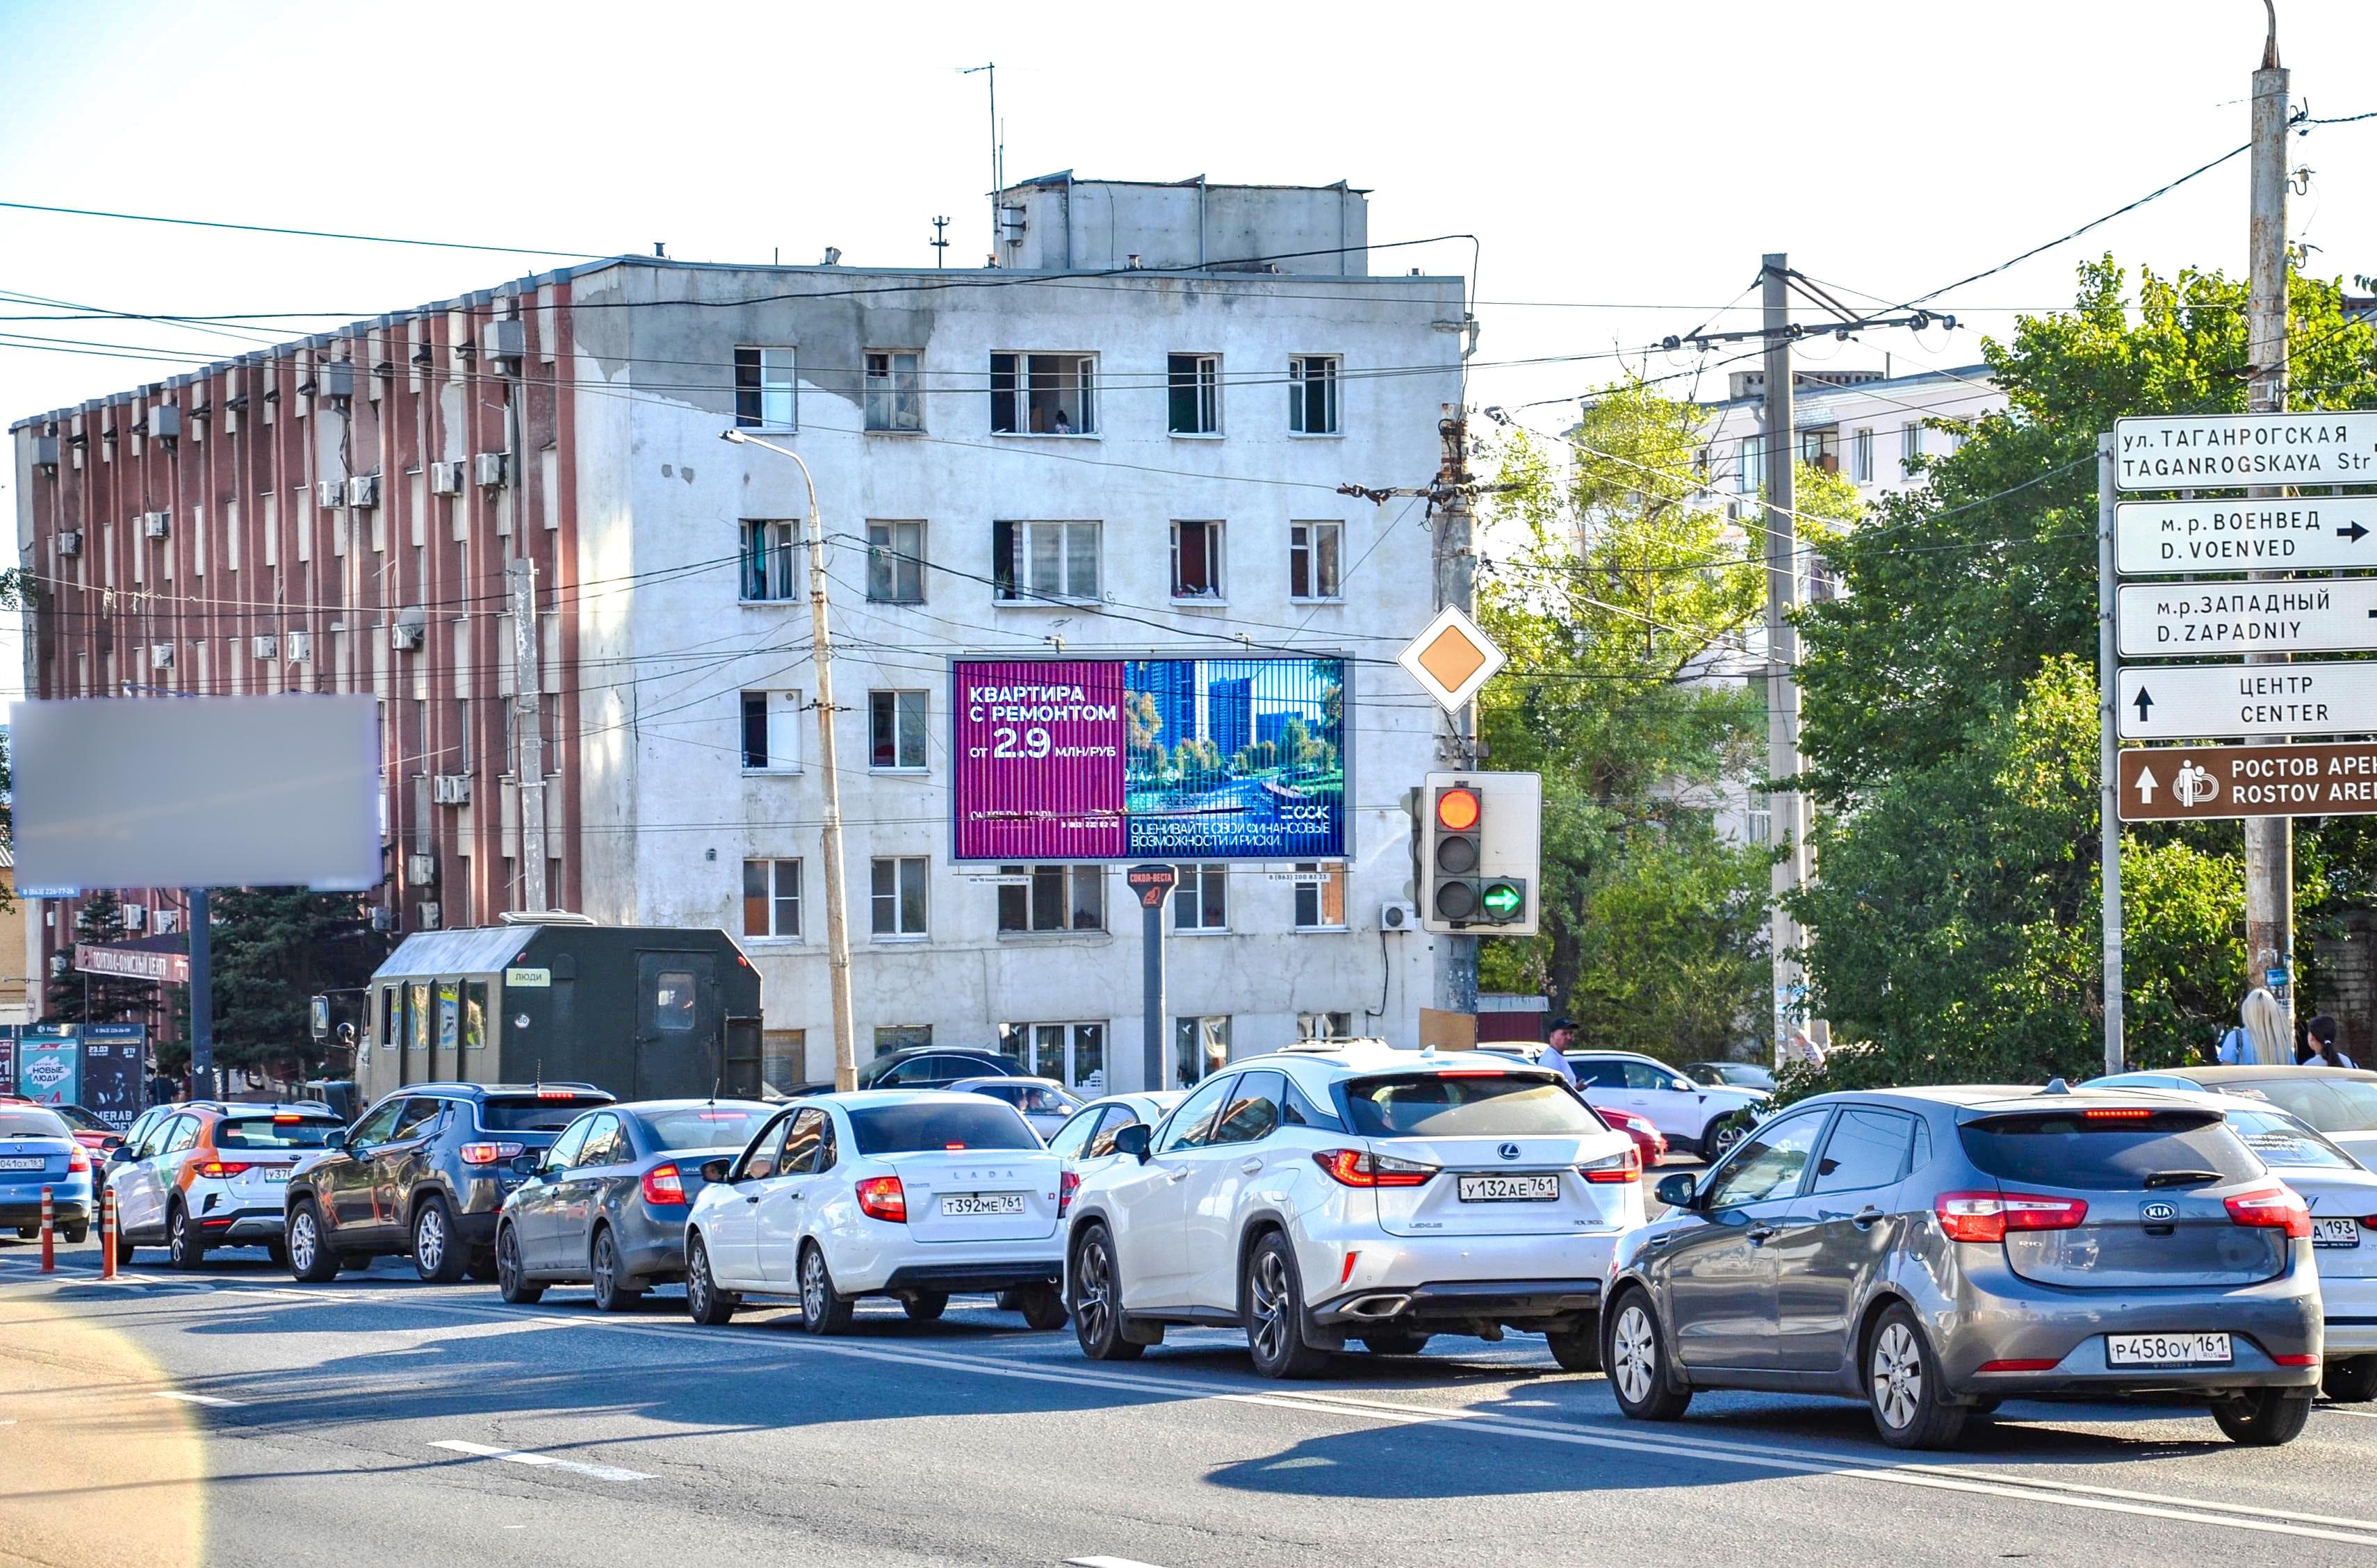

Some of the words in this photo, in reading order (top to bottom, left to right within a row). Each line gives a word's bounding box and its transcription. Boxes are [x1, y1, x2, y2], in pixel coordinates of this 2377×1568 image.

[2123, 435, 2154, 452] ул.
[2161, 426, 2346, 447] ТАГАНРОГСКАЯ
[2123, 453, 2321, 477] TAGANROGSKAYA
[2338, 452, 2371, 470] Str
[2189, 539, 2296, 559] VOENVED
[2185, 621, 2301, 642] ZAPADNIY
[970, 686, 1086, 703] КВАРТИРА
[2240, 677, 2313, 697] ЦЕНТР
[970, 705, 983, 723] С
[992, 705, 1116, 722] РЕМОНТОМ
[2241, 704, 2328, 723] CENTER
[993, 727, 1051, 759] 2.9
[2232, 759, 2319, 778] РОСТОВ
[2232, 783, 2320, 804] ROSTOV
[1131, 821, 1209, 835] ОЦЕНИВАЙТЕ
[1211, 822, 1244, 834] СВОИ
[1247, 822, 1330, 834] ФИНАНСОВЫЕ
[1131, 835, 1228, 847] ВОЗМОЖНОСТИ
[1129, 873, 1173, 883] СОКОЛ-ВЕСТА
[515, 973, 542, 981] ЛЮДИ
[94, 1110, 133, 1121] MERAB
[953, 1170, 1014, 1179] LADA
[1466, 1180, 1527, 1197] У132АЕ
[1530, 1178, 1554, 1192] 761
[948, 1198, 999, 1213] Т392МЕ
[1002, 1197, 1021, 1208] 761
[2148, 1207, 2170, 1216] KIA
[2326, 1220, 2354, 1234] 193
[2116, 1338, 2191, 1360] Р458ОУ
[2196, 1336, 2225, 1352] 161
